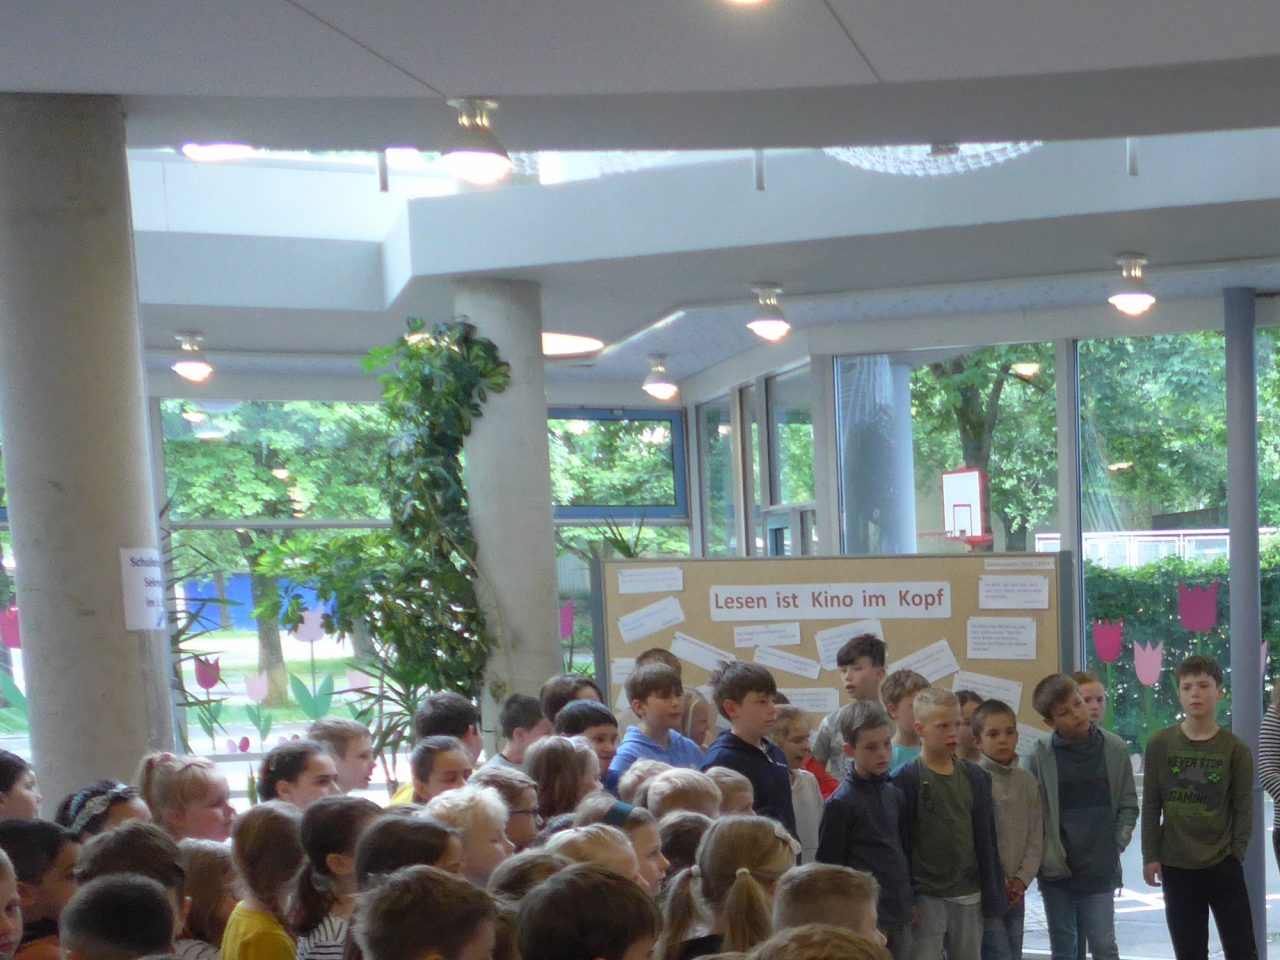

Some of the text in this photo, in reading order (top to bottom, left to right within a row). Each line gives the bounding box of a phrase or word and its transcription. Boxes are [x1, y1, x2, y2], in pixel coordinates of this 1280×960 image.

[714, 588, 944, 610] Lesen ist Kino im Kopf
[1167, 756, 1195, 769] NEVER
